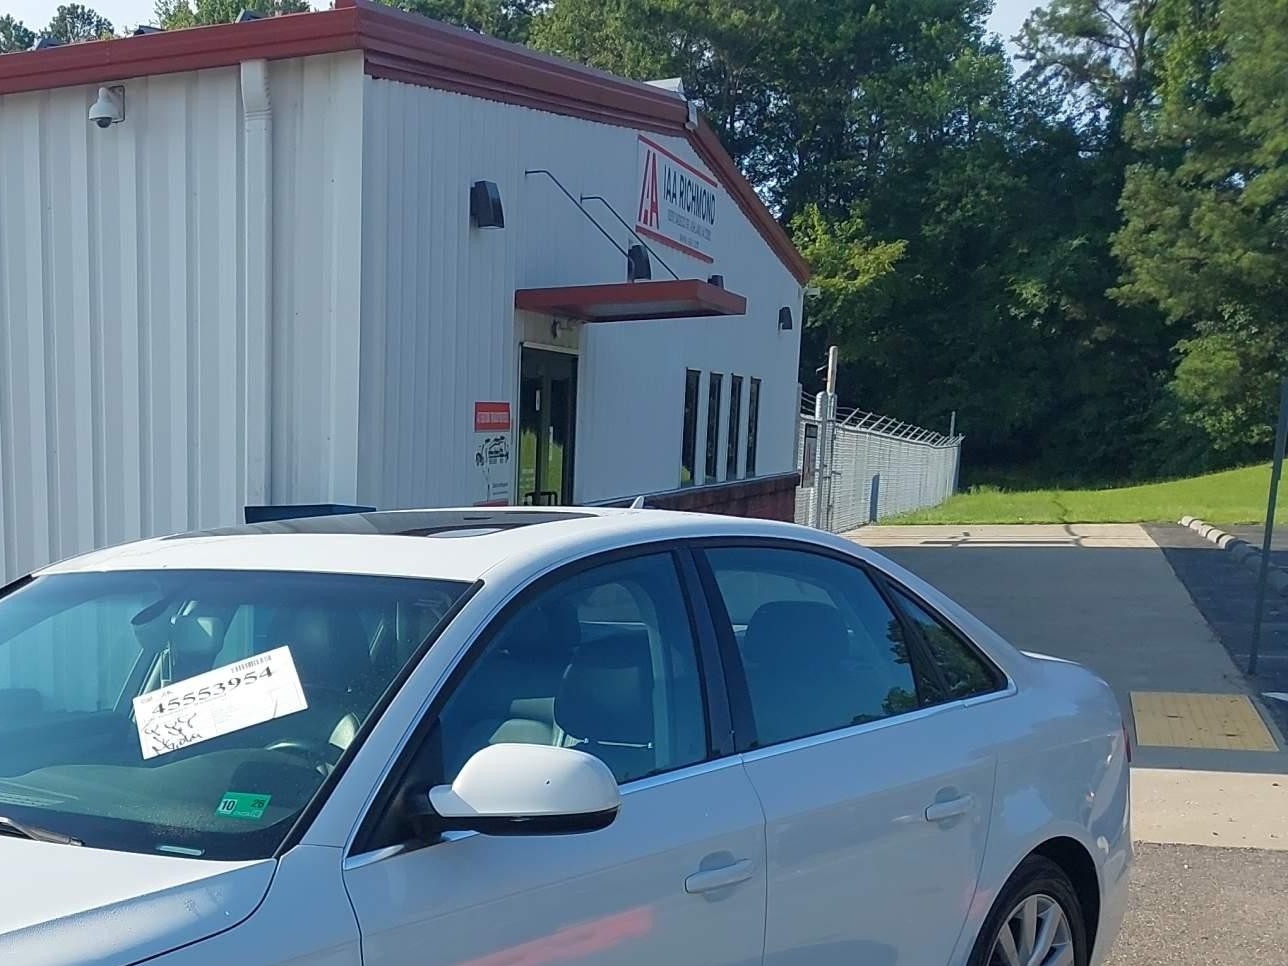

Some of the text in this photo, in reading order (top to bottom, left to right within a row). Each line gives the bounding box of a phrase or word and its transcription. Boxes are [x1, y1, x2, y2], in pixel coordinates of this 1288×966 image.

[663, 164, 678, 206] IAA
[678, 174, 716, 225] RICHMOND
[152, 666, 273, 714] 45553954
[221, 800, 236, 811] 10
